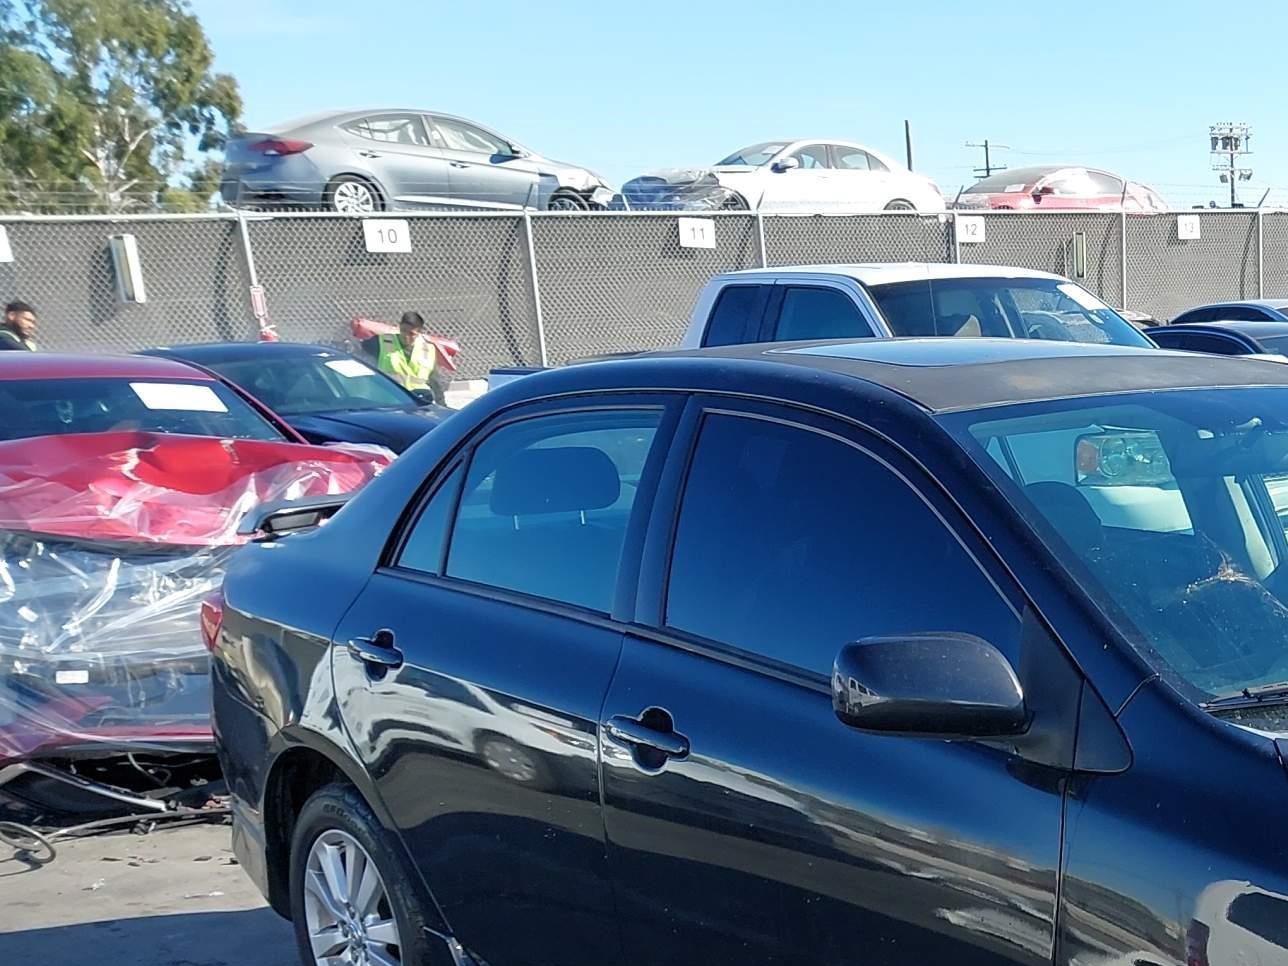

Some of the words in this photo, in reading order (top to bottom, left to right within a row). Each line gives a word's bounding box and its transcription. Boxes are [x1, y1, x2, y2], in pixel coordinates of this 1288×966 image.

[377, 228, 398, 244] 10
[690, 226, 705, 241] 11
[964, 223, 977, 236] 12
